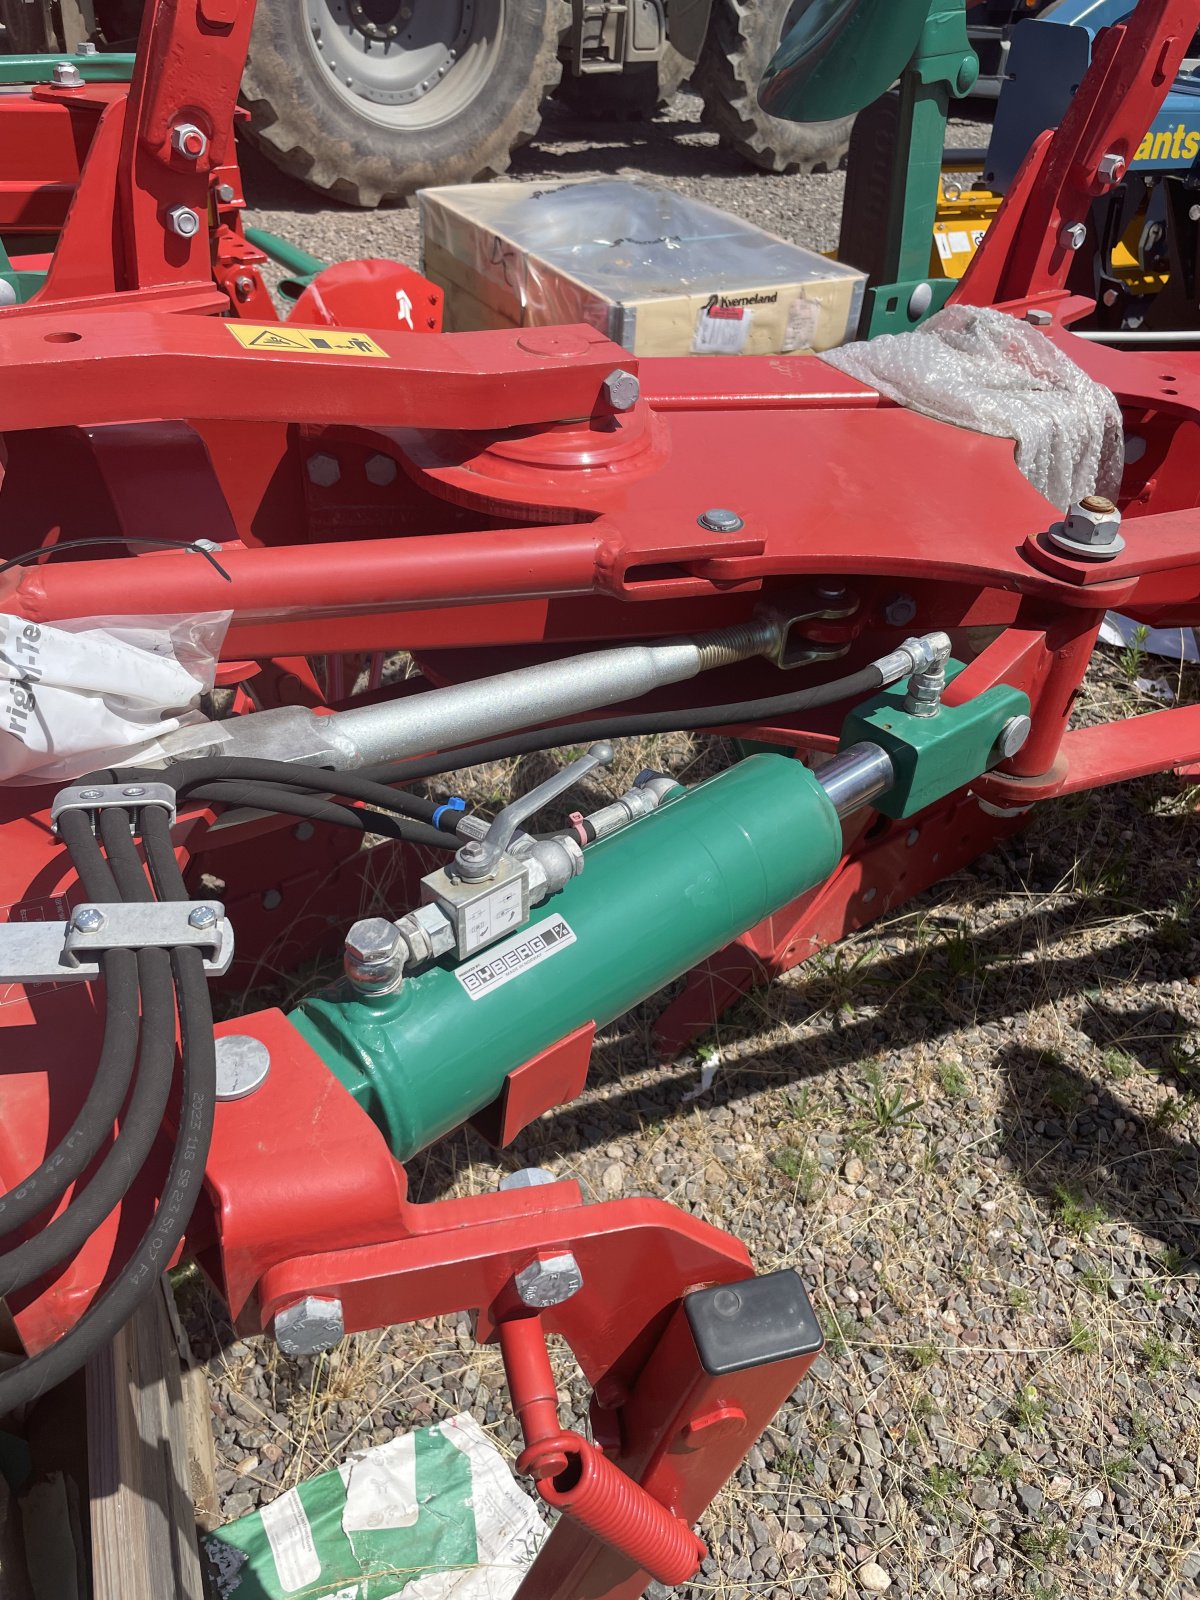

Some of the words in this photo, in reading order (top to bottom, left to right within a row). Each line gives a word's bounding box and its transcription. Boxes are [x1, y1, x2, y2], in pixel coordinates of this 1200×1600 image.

[1133, 124, 1200, 160] ants
[721, 291, 778, 307] Kverneland
[463, 936, 546, 991] BYBERG
